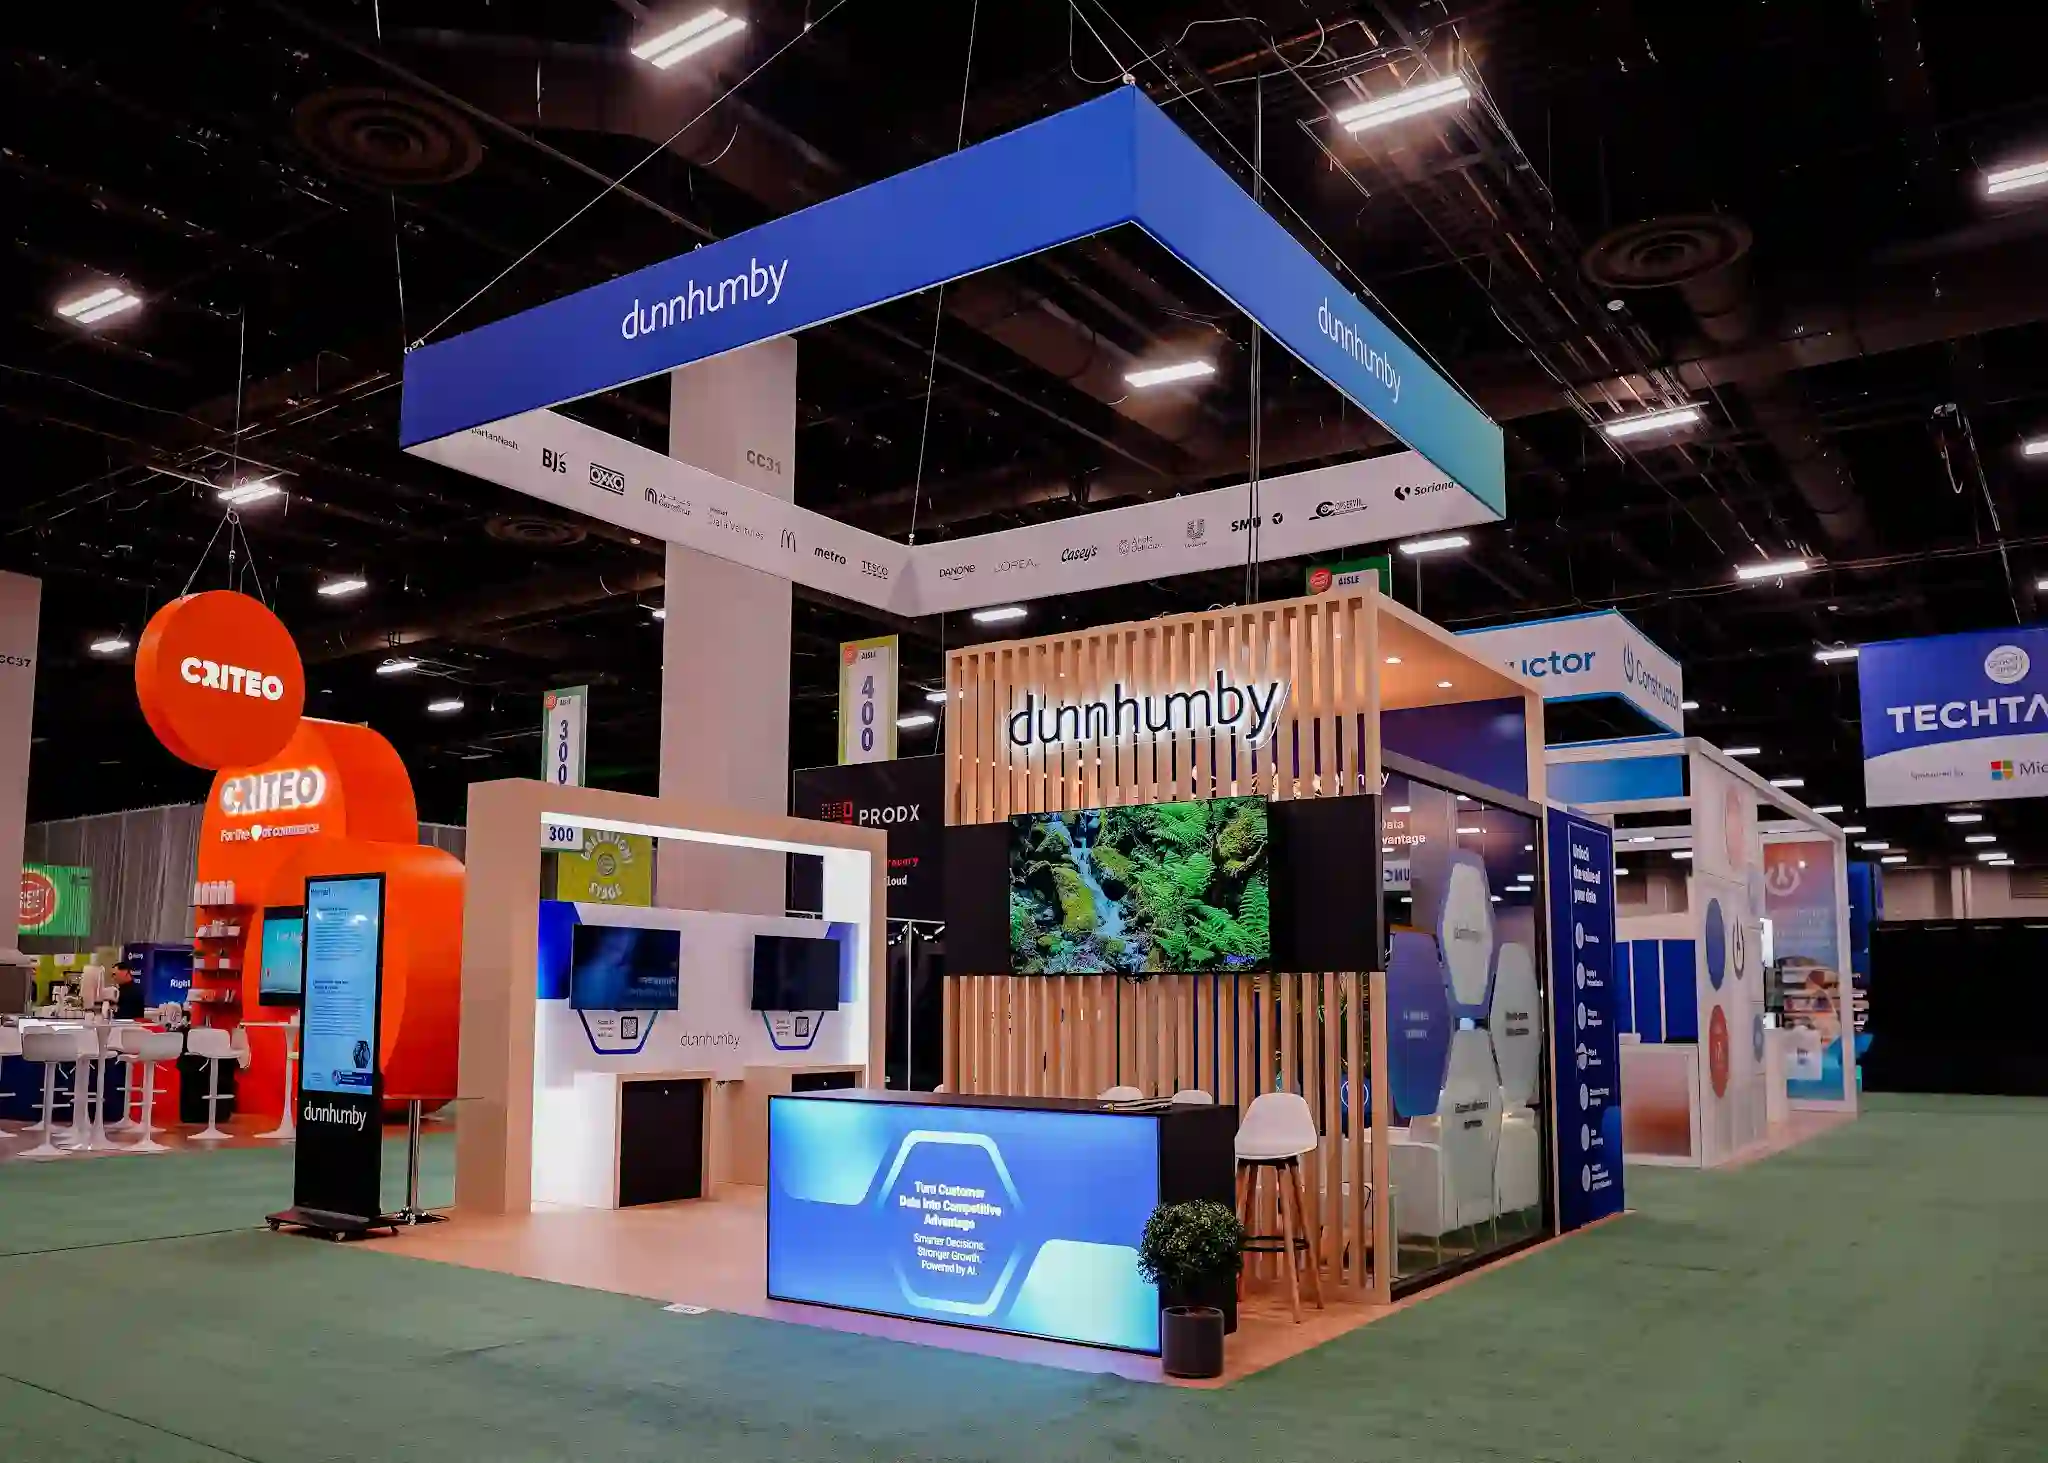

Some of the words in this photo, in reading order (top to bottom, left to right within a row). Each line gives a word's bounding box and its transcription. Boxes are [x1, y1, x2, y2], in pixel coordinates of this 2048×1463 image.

[621, 257, 788, 339] dunnhumby
[1318, 296, 1401, 404] dunnhumby
[746, 450, 782, 475] CC31
[590, 467, 625, 492] OXXO
[1414, 481, 1455, 496] Soriana
[1231, 516, 1262, 533] SMU
[814, 546, 847, 566] metro
[1061, 544, 1098, 564] Casey's
[861, 560, 889, 577] TESCO
[1338, 575, 1360, 585] AISLE
[180, 656, 284, 701] CRITEO
[1636, 659, 1680, 714] Constructor
[861, 675, 875, 752] 400
[1008, 668, 1280, 747] dunnhumby
[558, 719, 569, 785] 300
[221, 768, 321, 815] CRITEO
[859, 803, 920, 825] PRODX
[548, 825, 574, 842] 300
[1382, 833, 1426, 847] vantage
[885, 874, 908, 886] loud
[680, 1030, 741, 1051] dunnhumby
[304, 1101, 367, 1132] dunnhumby
[914, 1180, 937, 1195] Turn
[938, 1183, 986, 1199] Customer
[899, 1194, 921, 1209] Data
[943, 1199, 1002, 1217] Competitive
[923, 1213, 976, 1232] Advantage
[913, 1232, 944, 1246] Smarter
[916, 1245, 950, 1261] Stronger
[921, 1259, 955, 1273] Powered
[955, 1263, 966, 1277] by
